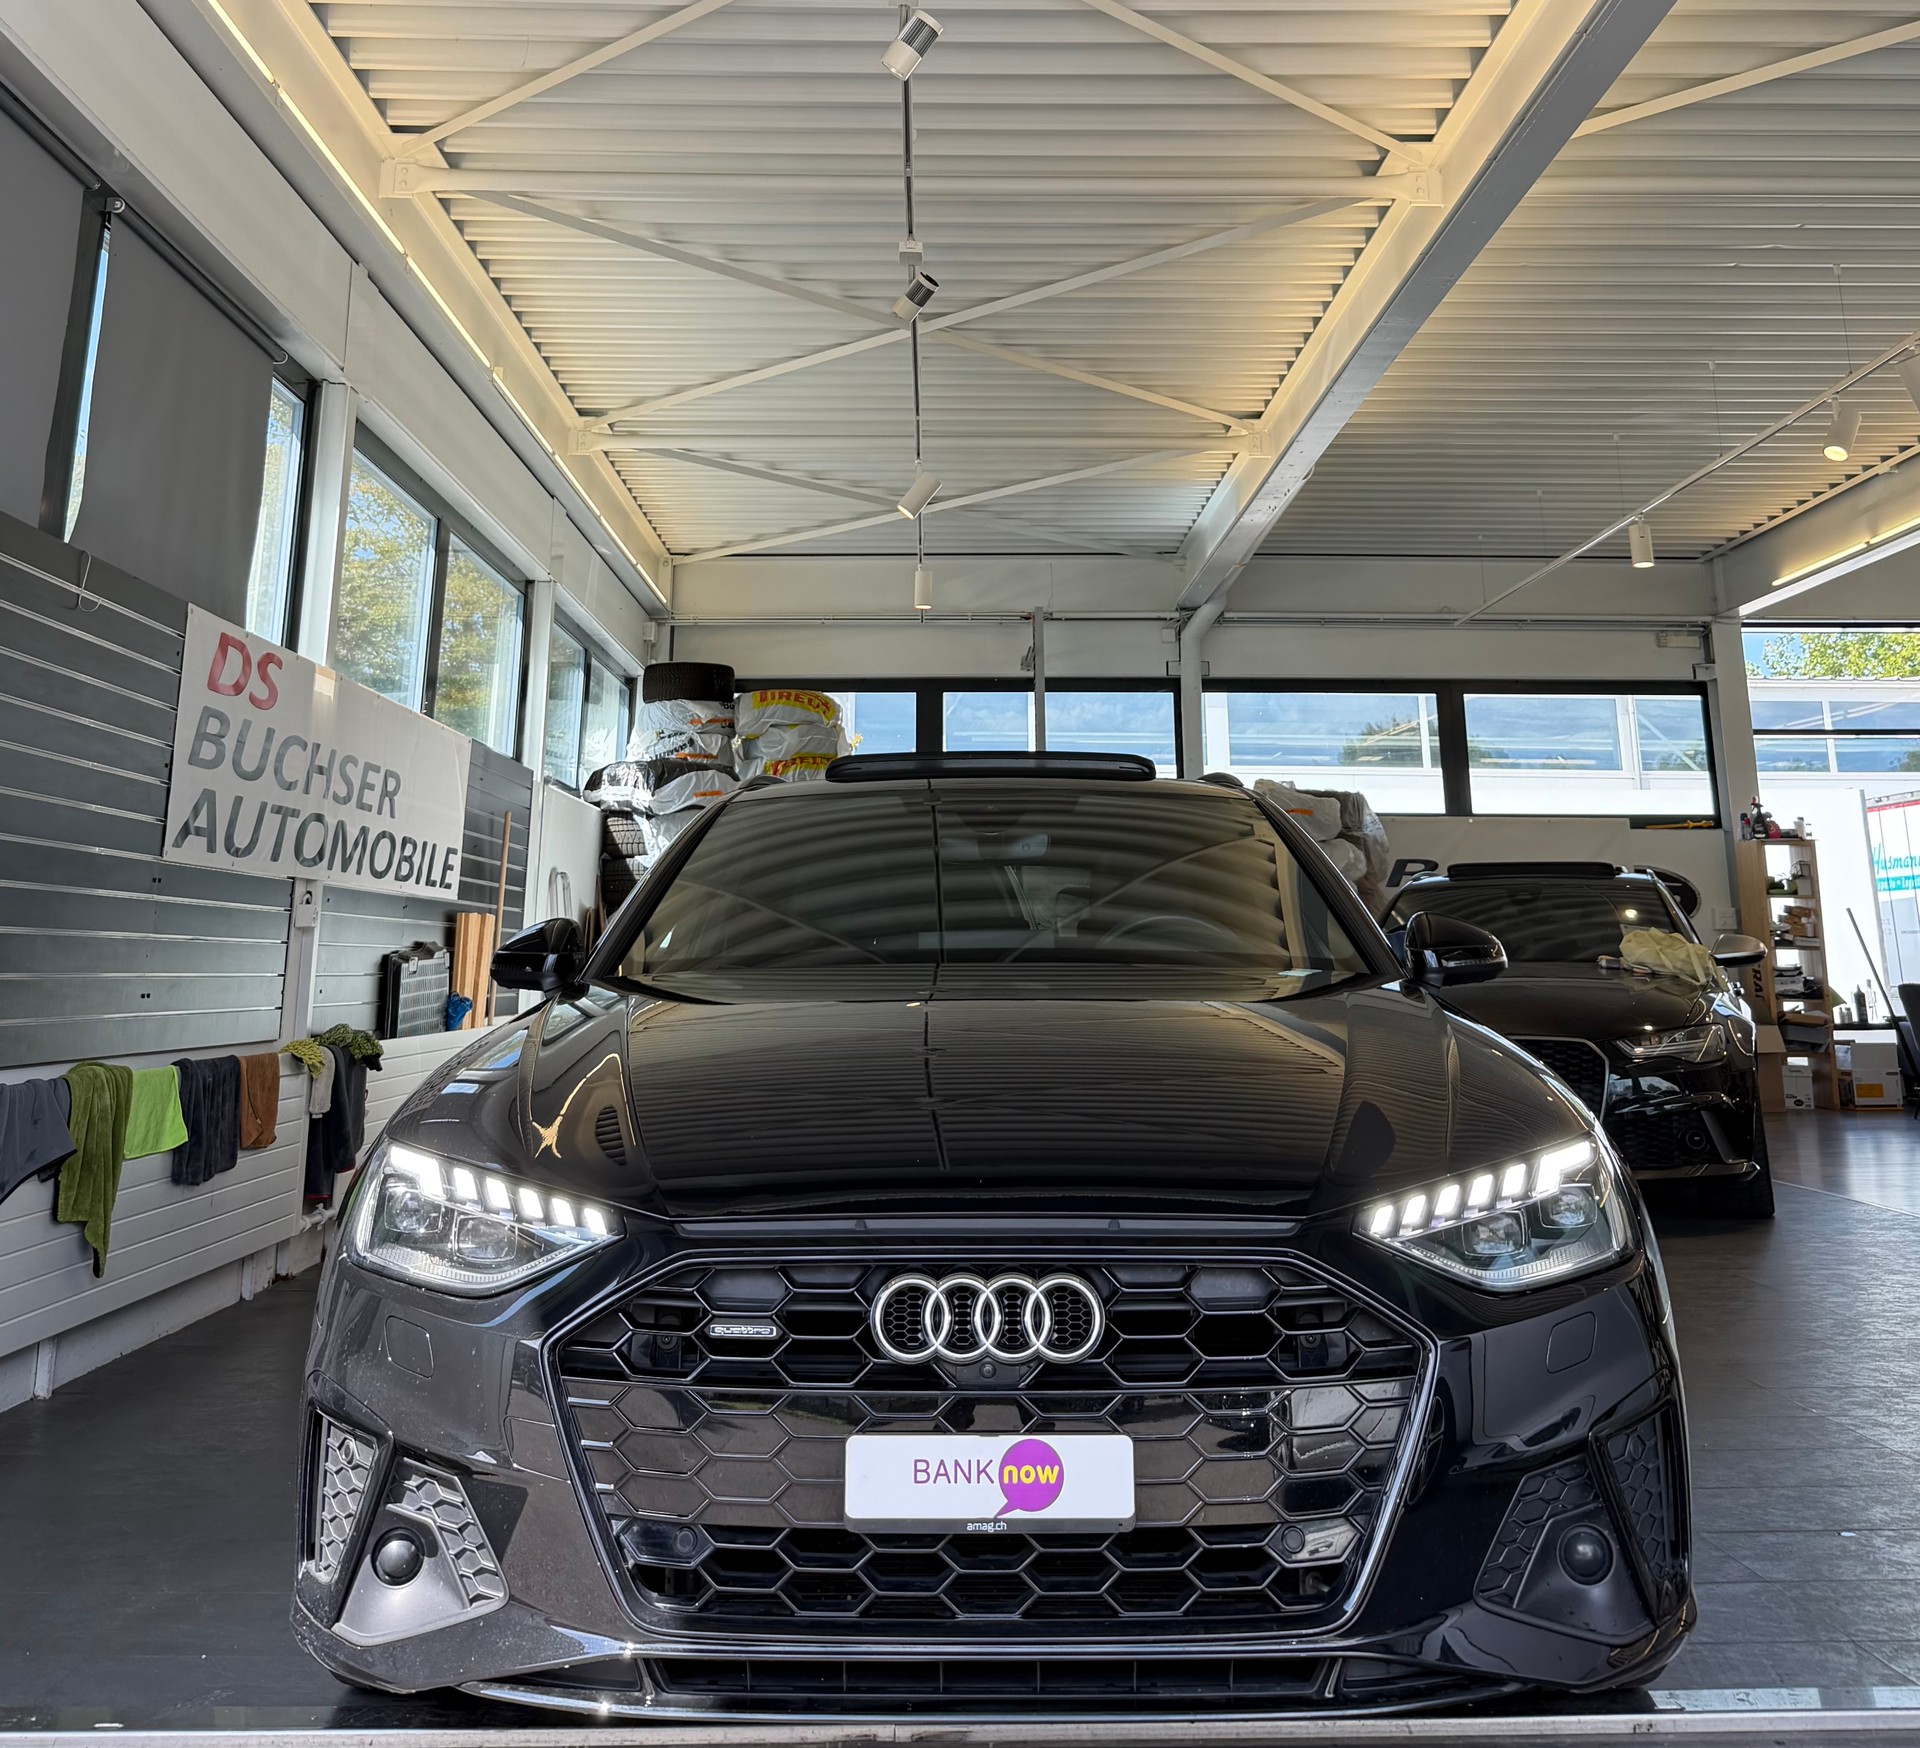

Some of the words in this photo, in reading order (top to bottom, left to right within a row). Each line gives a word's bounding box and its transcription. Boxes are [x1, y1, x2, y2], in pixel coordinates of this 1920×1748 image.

[207, 631, 283, 711] DS
[187, 705, 402, 819] BUCHSER
[172, 788, 459, 890] AUTOMOBILE
[1872, 843, 1920, 875] Husman
[913, 1458, 995, 1484] BANK
[1002, 1464, 1060, 1484] now
[966, 1521, 1007, 1532] amag.ch
